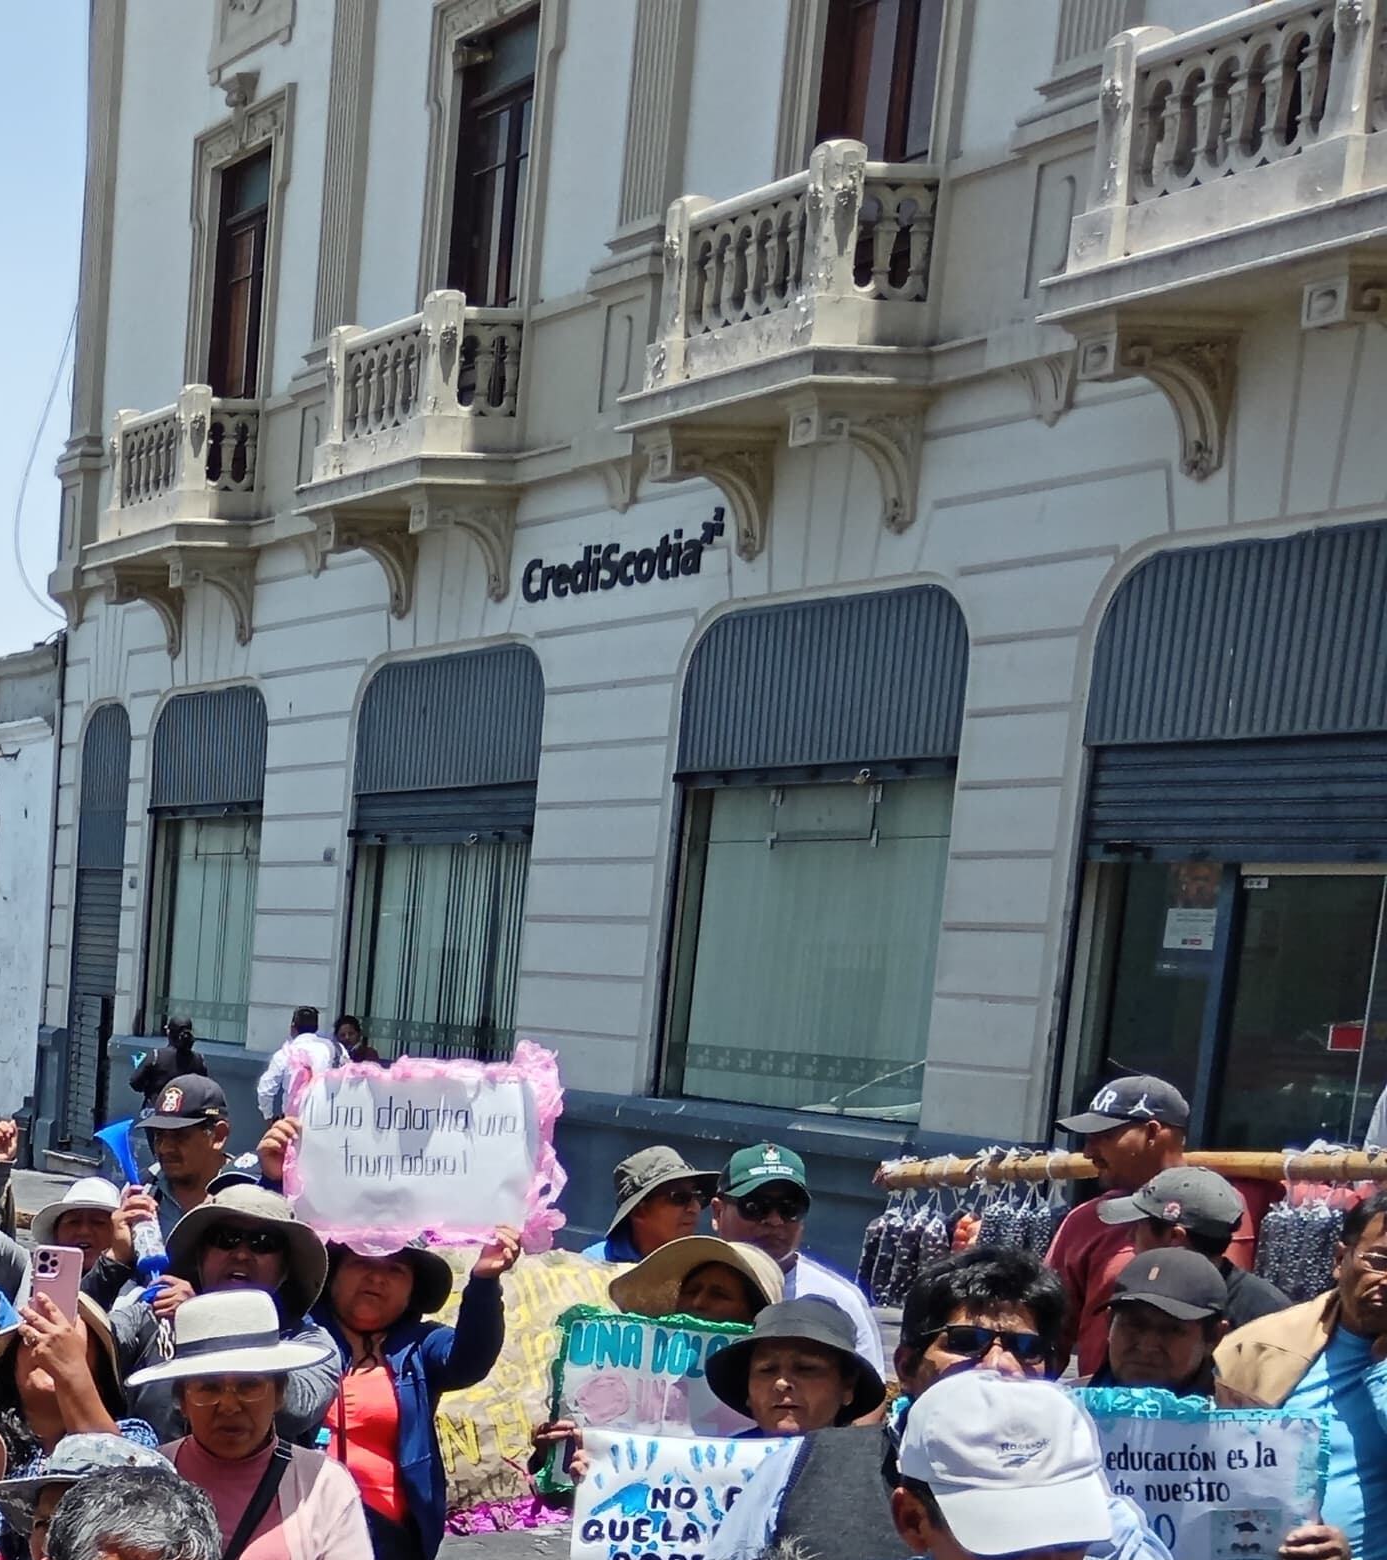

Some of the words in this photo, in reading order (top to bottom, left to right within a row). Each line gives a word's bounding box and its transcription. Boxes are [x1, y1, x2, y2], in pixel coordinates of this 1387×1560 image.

[522, 528, 704, 604] CrediScotia
[569, 1320, 643, 1370] UNA
[1227, 1448, 1249, 1469] es
[1254, 1441, 1278, 1468] la
[650, 1486, 698, 1510] NO
[1145, 1480, 1231, 1503] nuestro
[581, 1518, 651, 1543] QUE
[662, 1522, 701, 1543] LA
